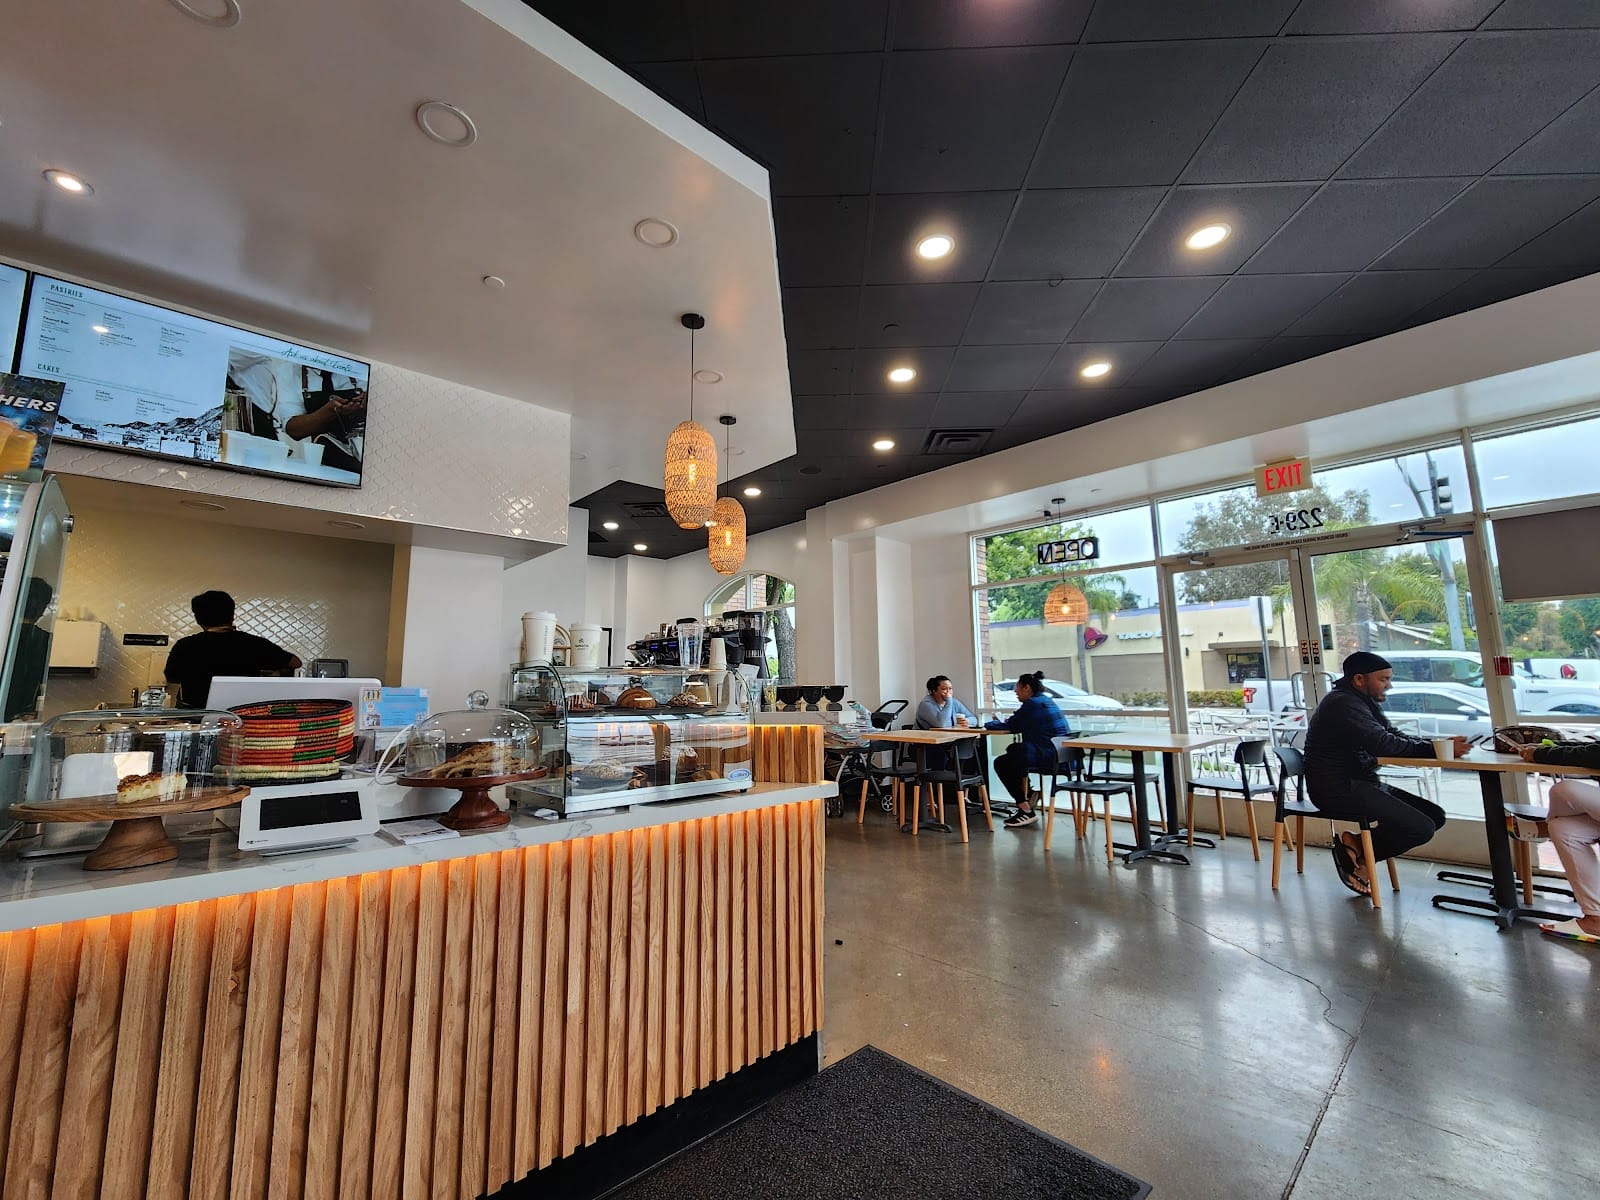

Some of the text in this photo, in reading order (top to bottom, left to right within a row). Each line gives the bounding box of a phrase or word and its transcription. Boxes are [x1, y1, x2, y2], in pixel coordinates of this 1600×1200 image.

[50, 284, 83, 298] PASTRIES
[37, 363, 60, 374] CAKES
[1264, 463, 1302, 492] EXIT
